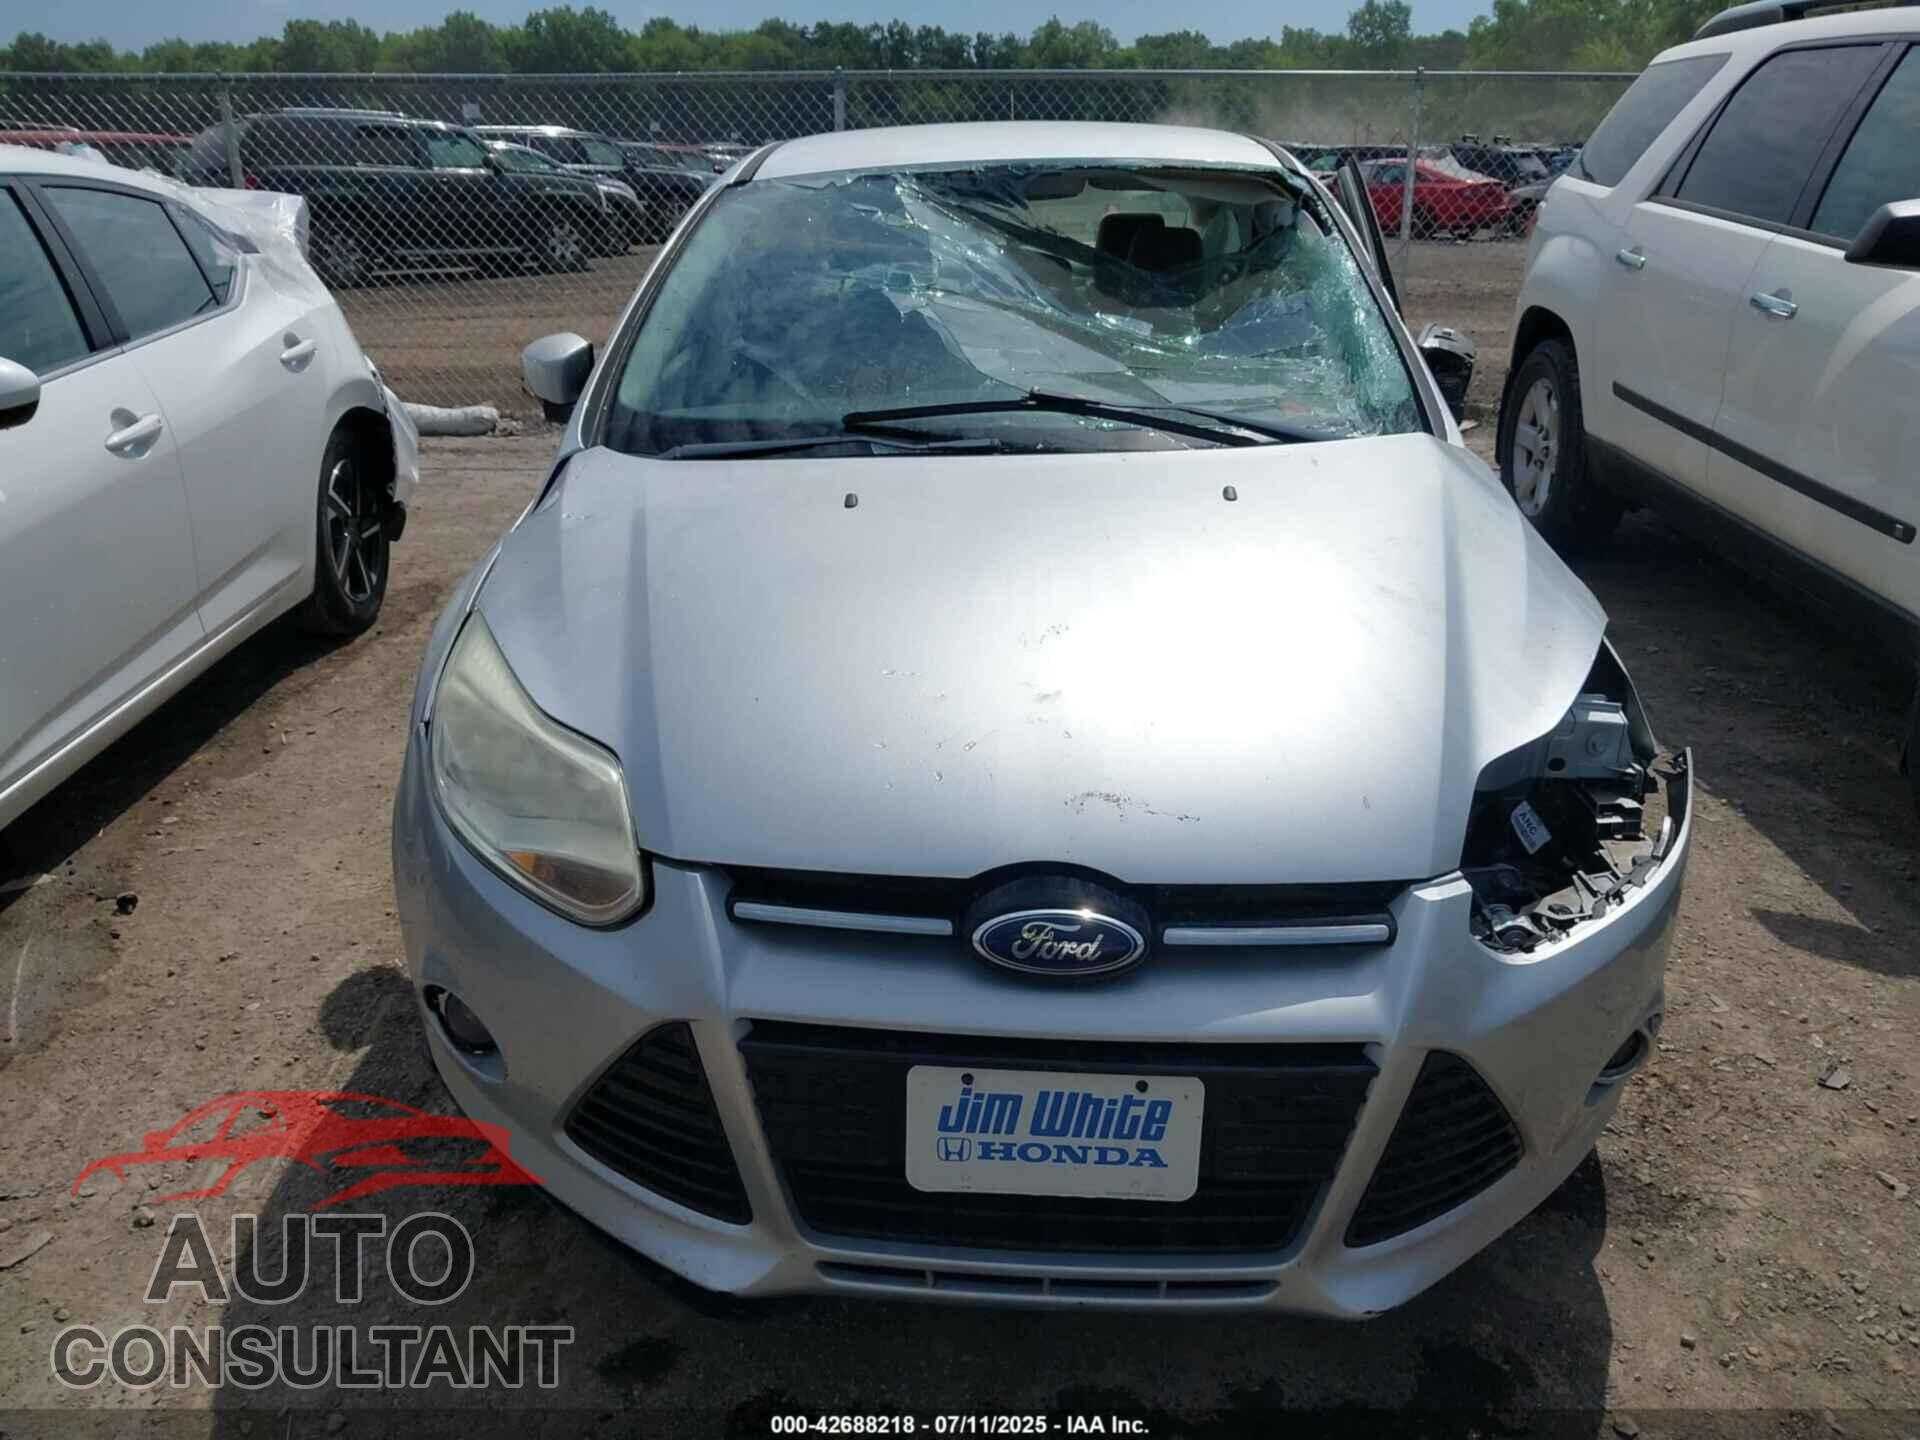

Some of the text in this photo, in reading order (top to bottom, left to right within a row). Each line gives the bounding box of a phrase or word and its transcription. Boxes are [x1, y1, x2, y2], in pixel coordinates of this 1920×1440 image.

[1011, 921, 1103, 961] Ford
[1029, 1090, 1174, 1142] White
[976, 1141, 1169, 1169] HONDA
